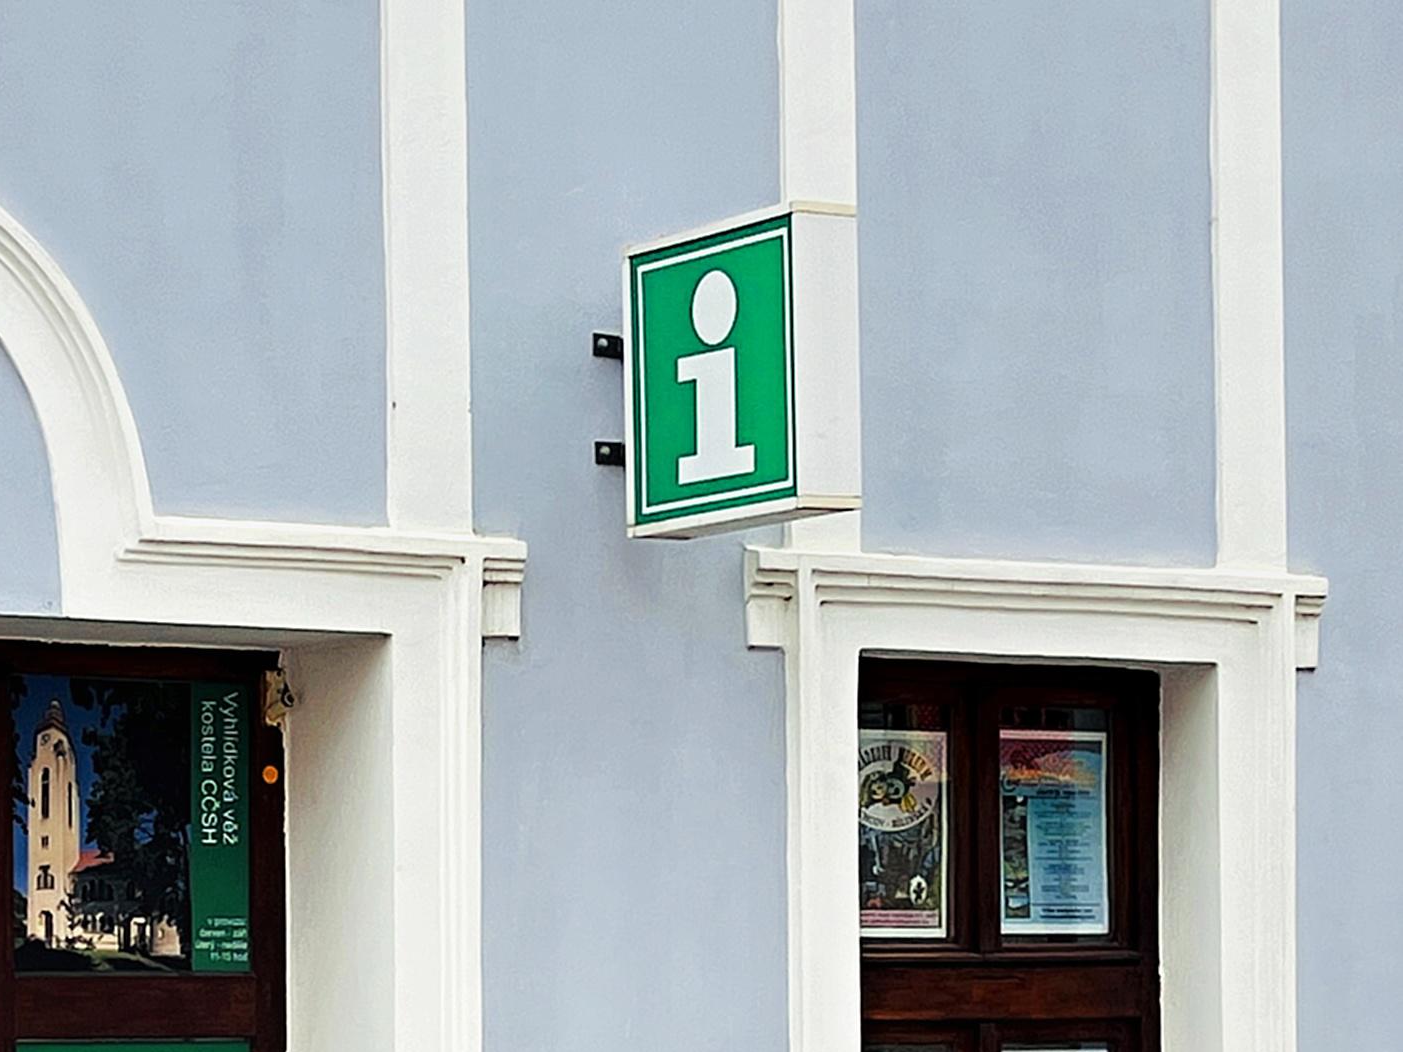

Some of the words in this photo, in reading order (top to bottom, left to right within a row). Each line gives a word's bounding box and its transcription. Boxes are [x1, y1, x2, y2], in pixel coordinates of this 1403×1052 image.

[201, 701, 218, 773] kostela
[219, 692, 239, 802] Vyhlídková
[201, 778, 220, 844] CČSH
[222, 808, 239, 846] věž
